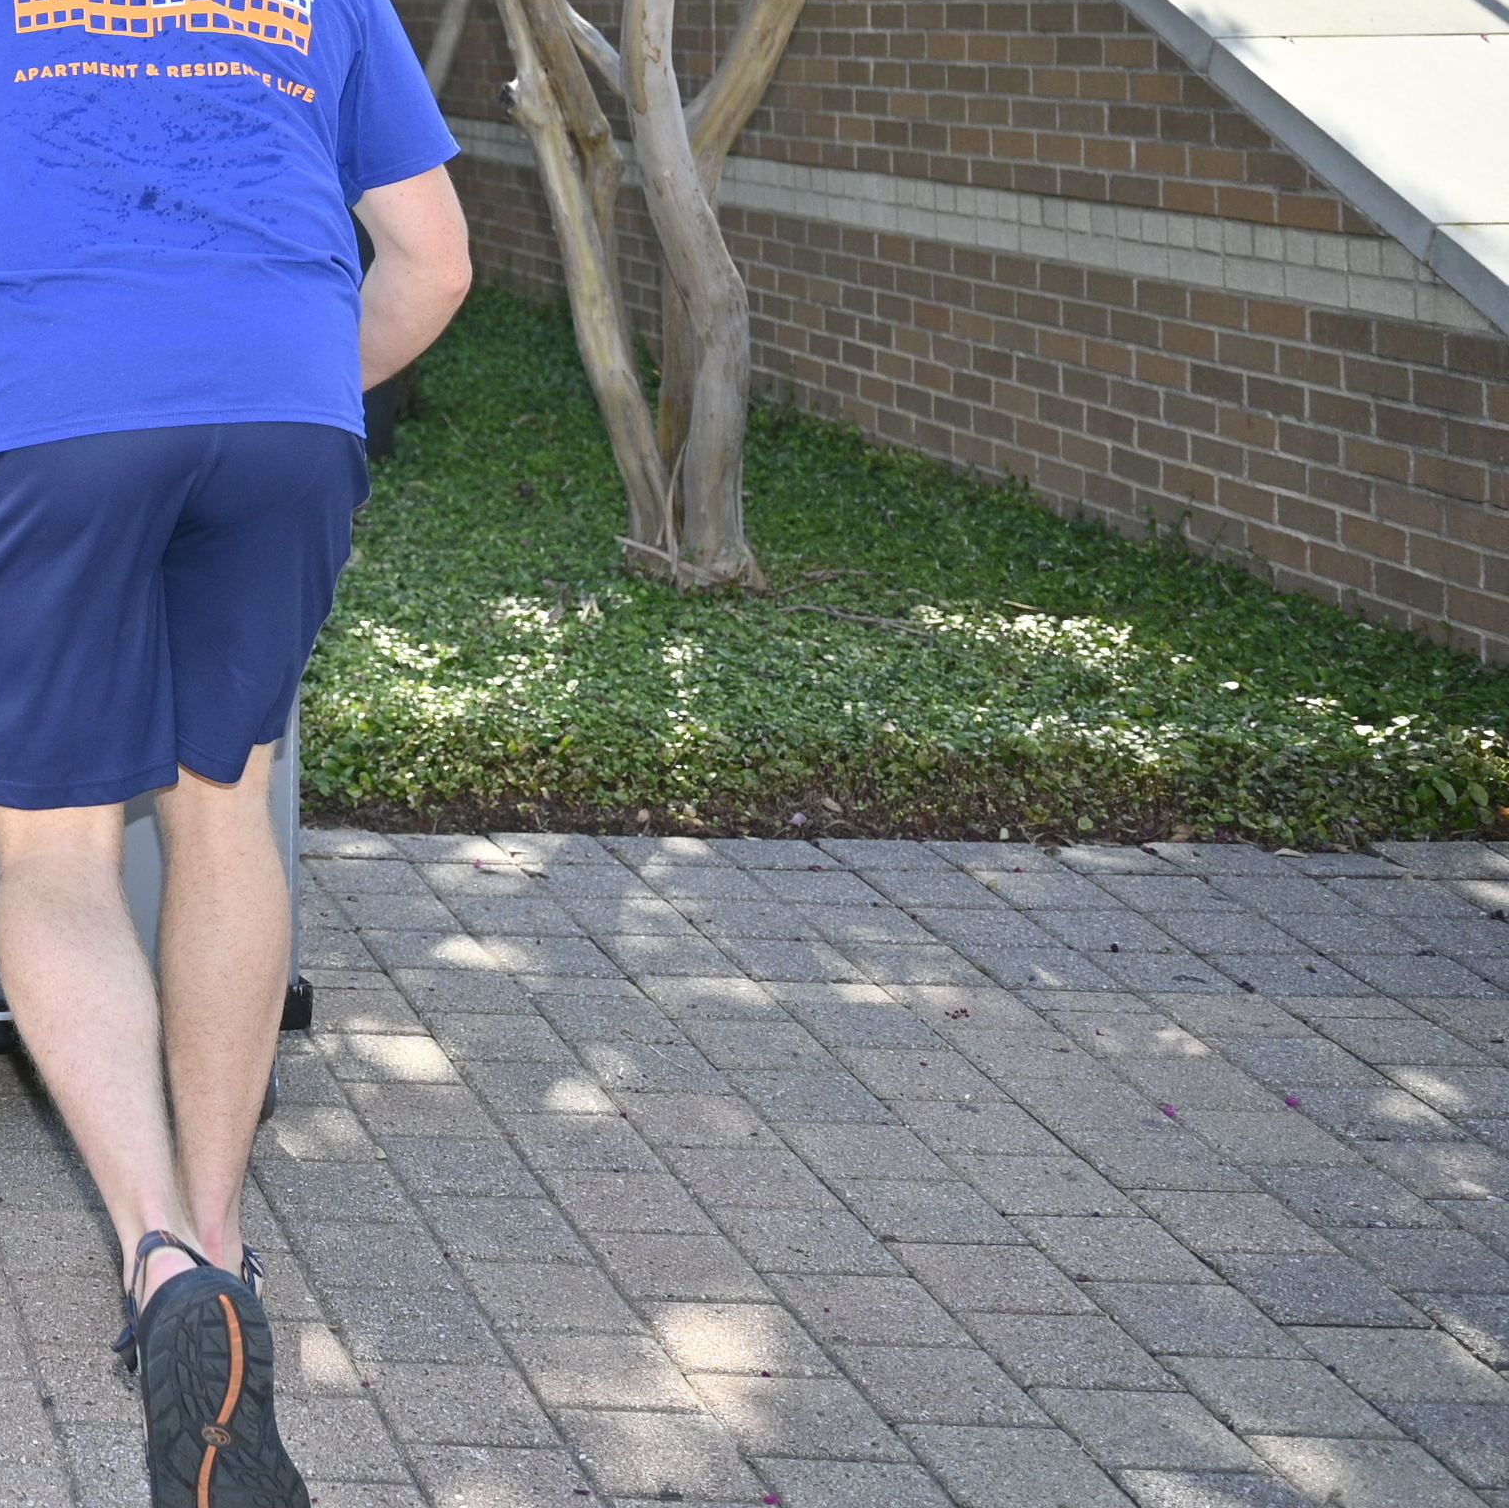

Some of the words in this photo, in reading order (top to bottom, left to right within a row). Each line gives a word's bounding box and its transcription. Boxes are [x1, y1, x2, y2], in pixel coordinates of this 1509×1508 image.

[14, 61, 139, 83] APARTMENT
[146, 63, 160, 76] &
[277, 77, 316, 103] LIFE
